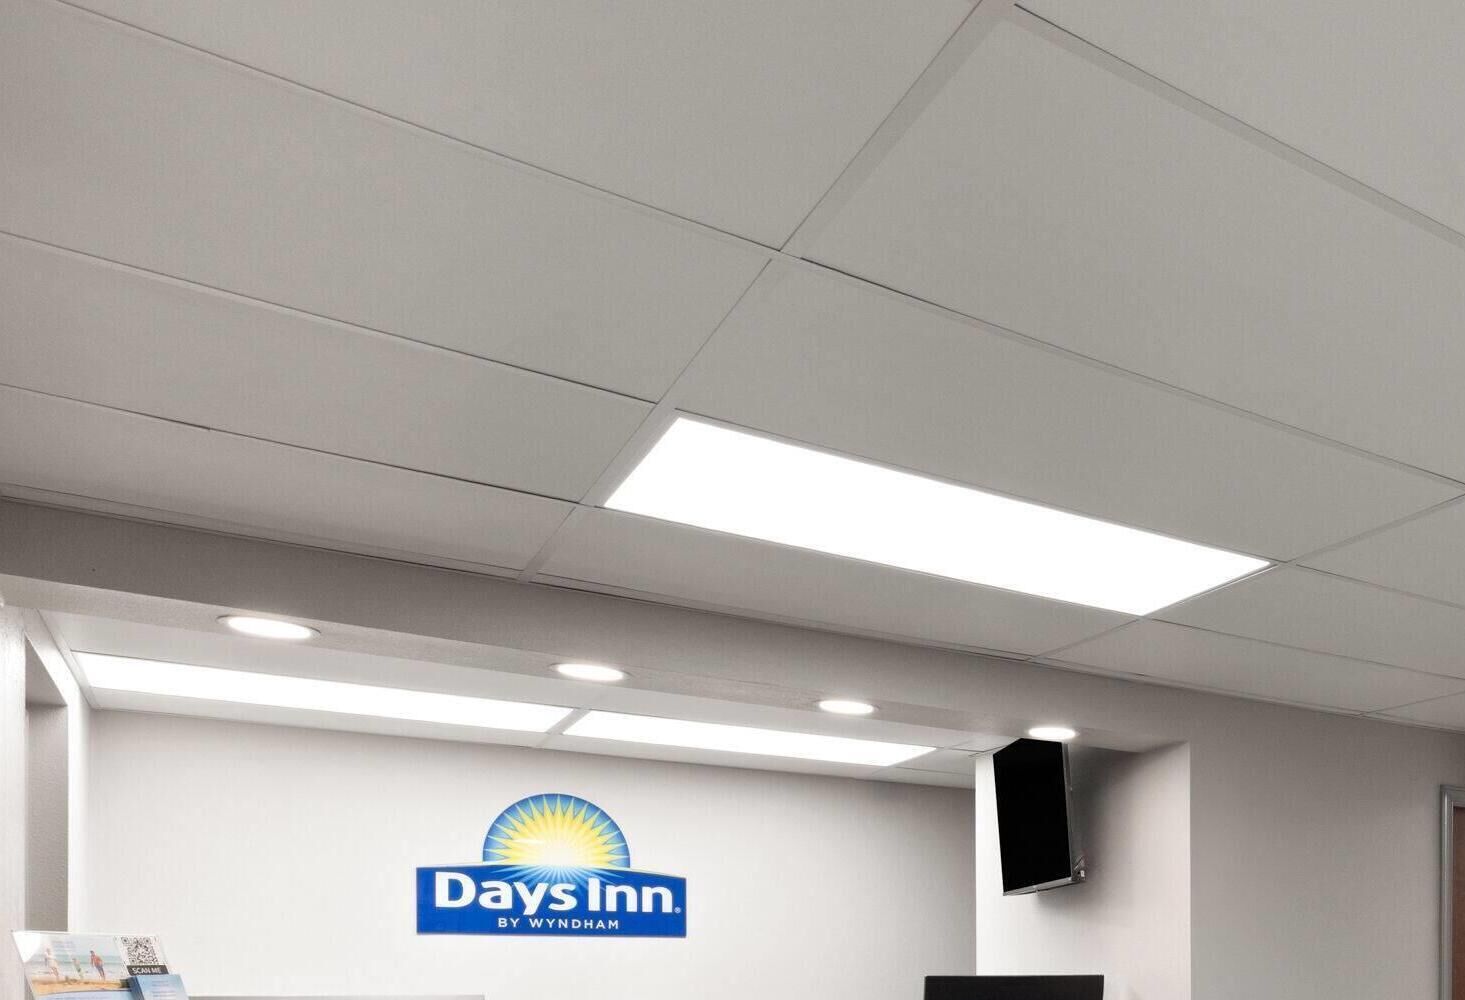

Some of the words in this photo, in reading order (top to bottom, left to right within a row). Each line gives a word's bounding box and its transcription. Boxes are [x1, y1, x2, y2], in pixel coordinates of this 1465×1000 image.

[435, 871, 578, 916] Days
[586, 875, 675, 914] Inn
[498, 917, 520, 929] BY
[529, 918, 619, 930] WYNDHAM
[132, 967, 151, 975] SCAN
